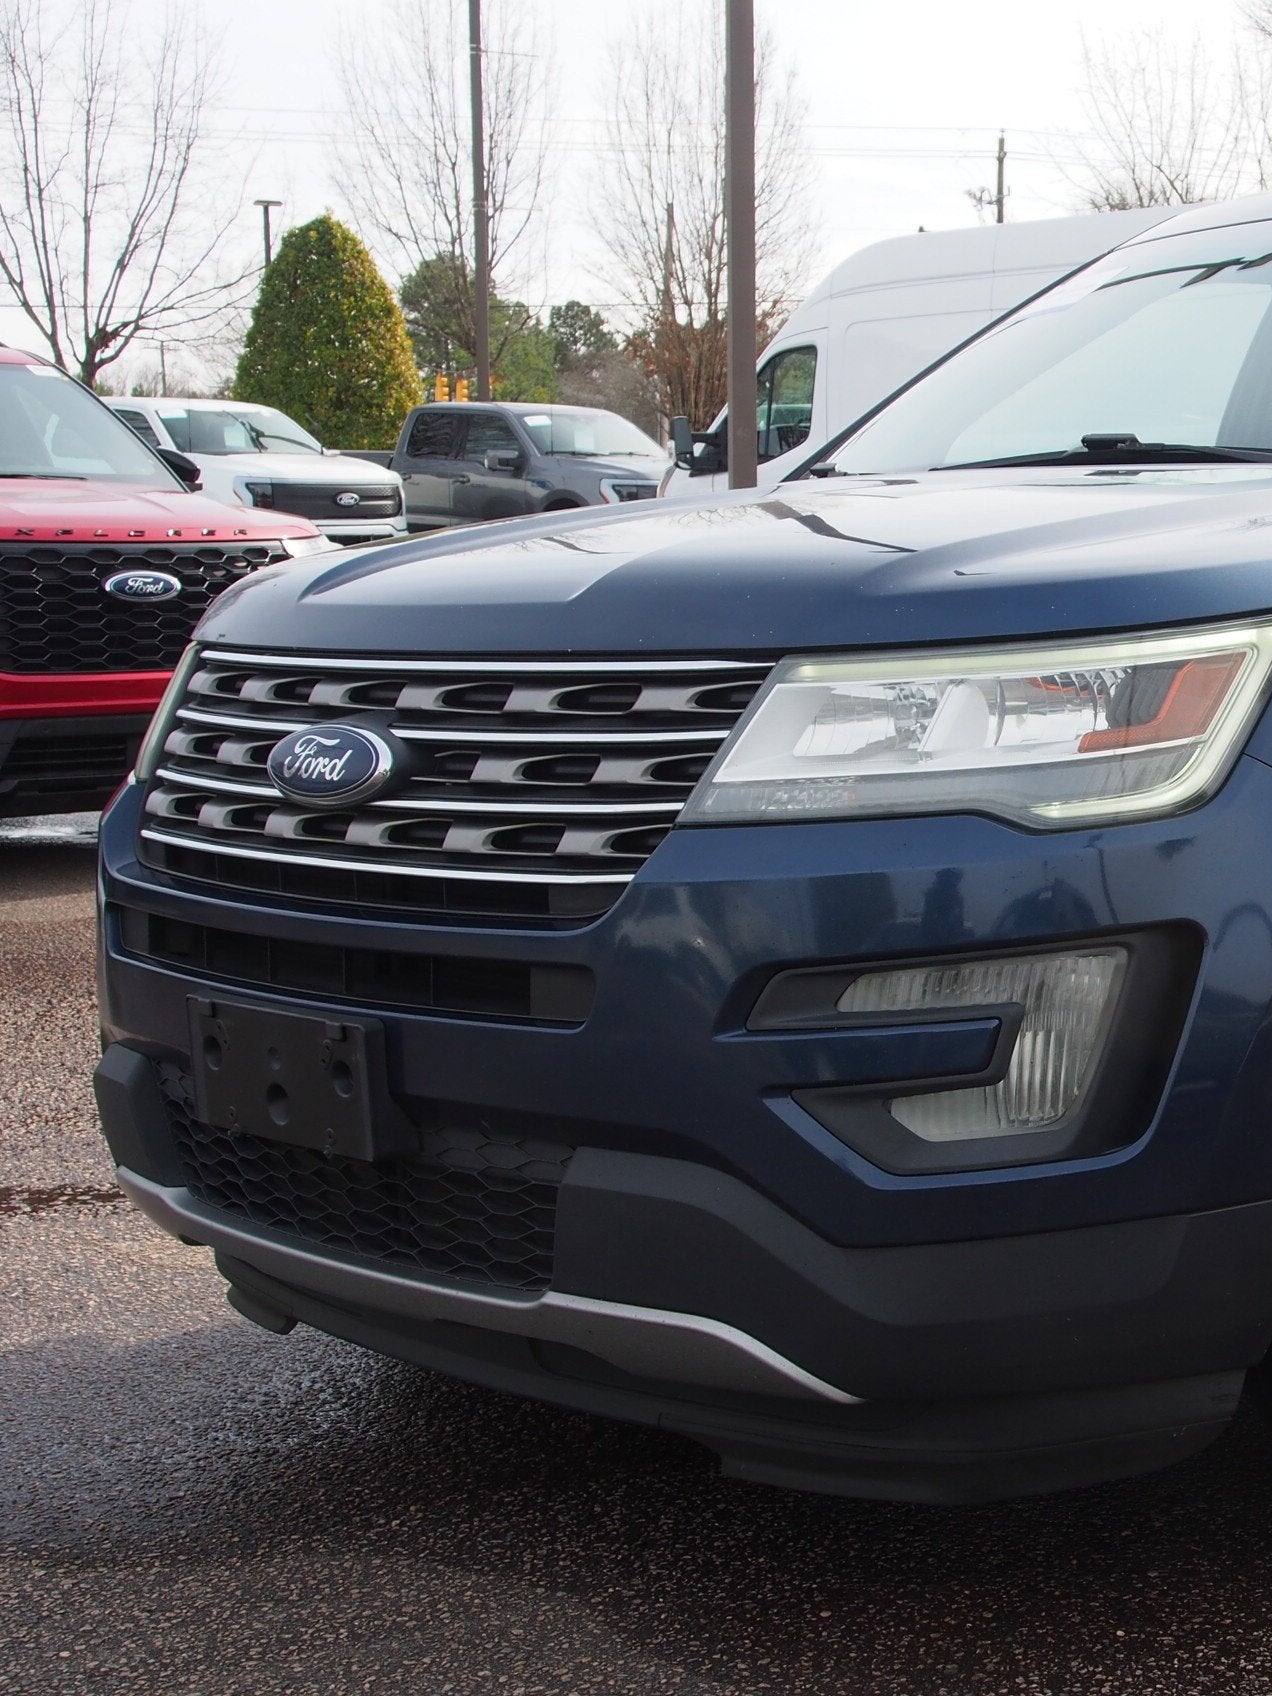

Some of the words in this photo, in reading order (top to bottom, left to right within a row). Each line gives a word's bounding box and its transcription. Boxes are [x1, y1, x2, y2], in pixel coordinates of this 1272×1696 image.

[14, 528, 248, 538] XPLORER
[125, 577, 165, 595] Ford
[283, 735, 353, 781] Ford
